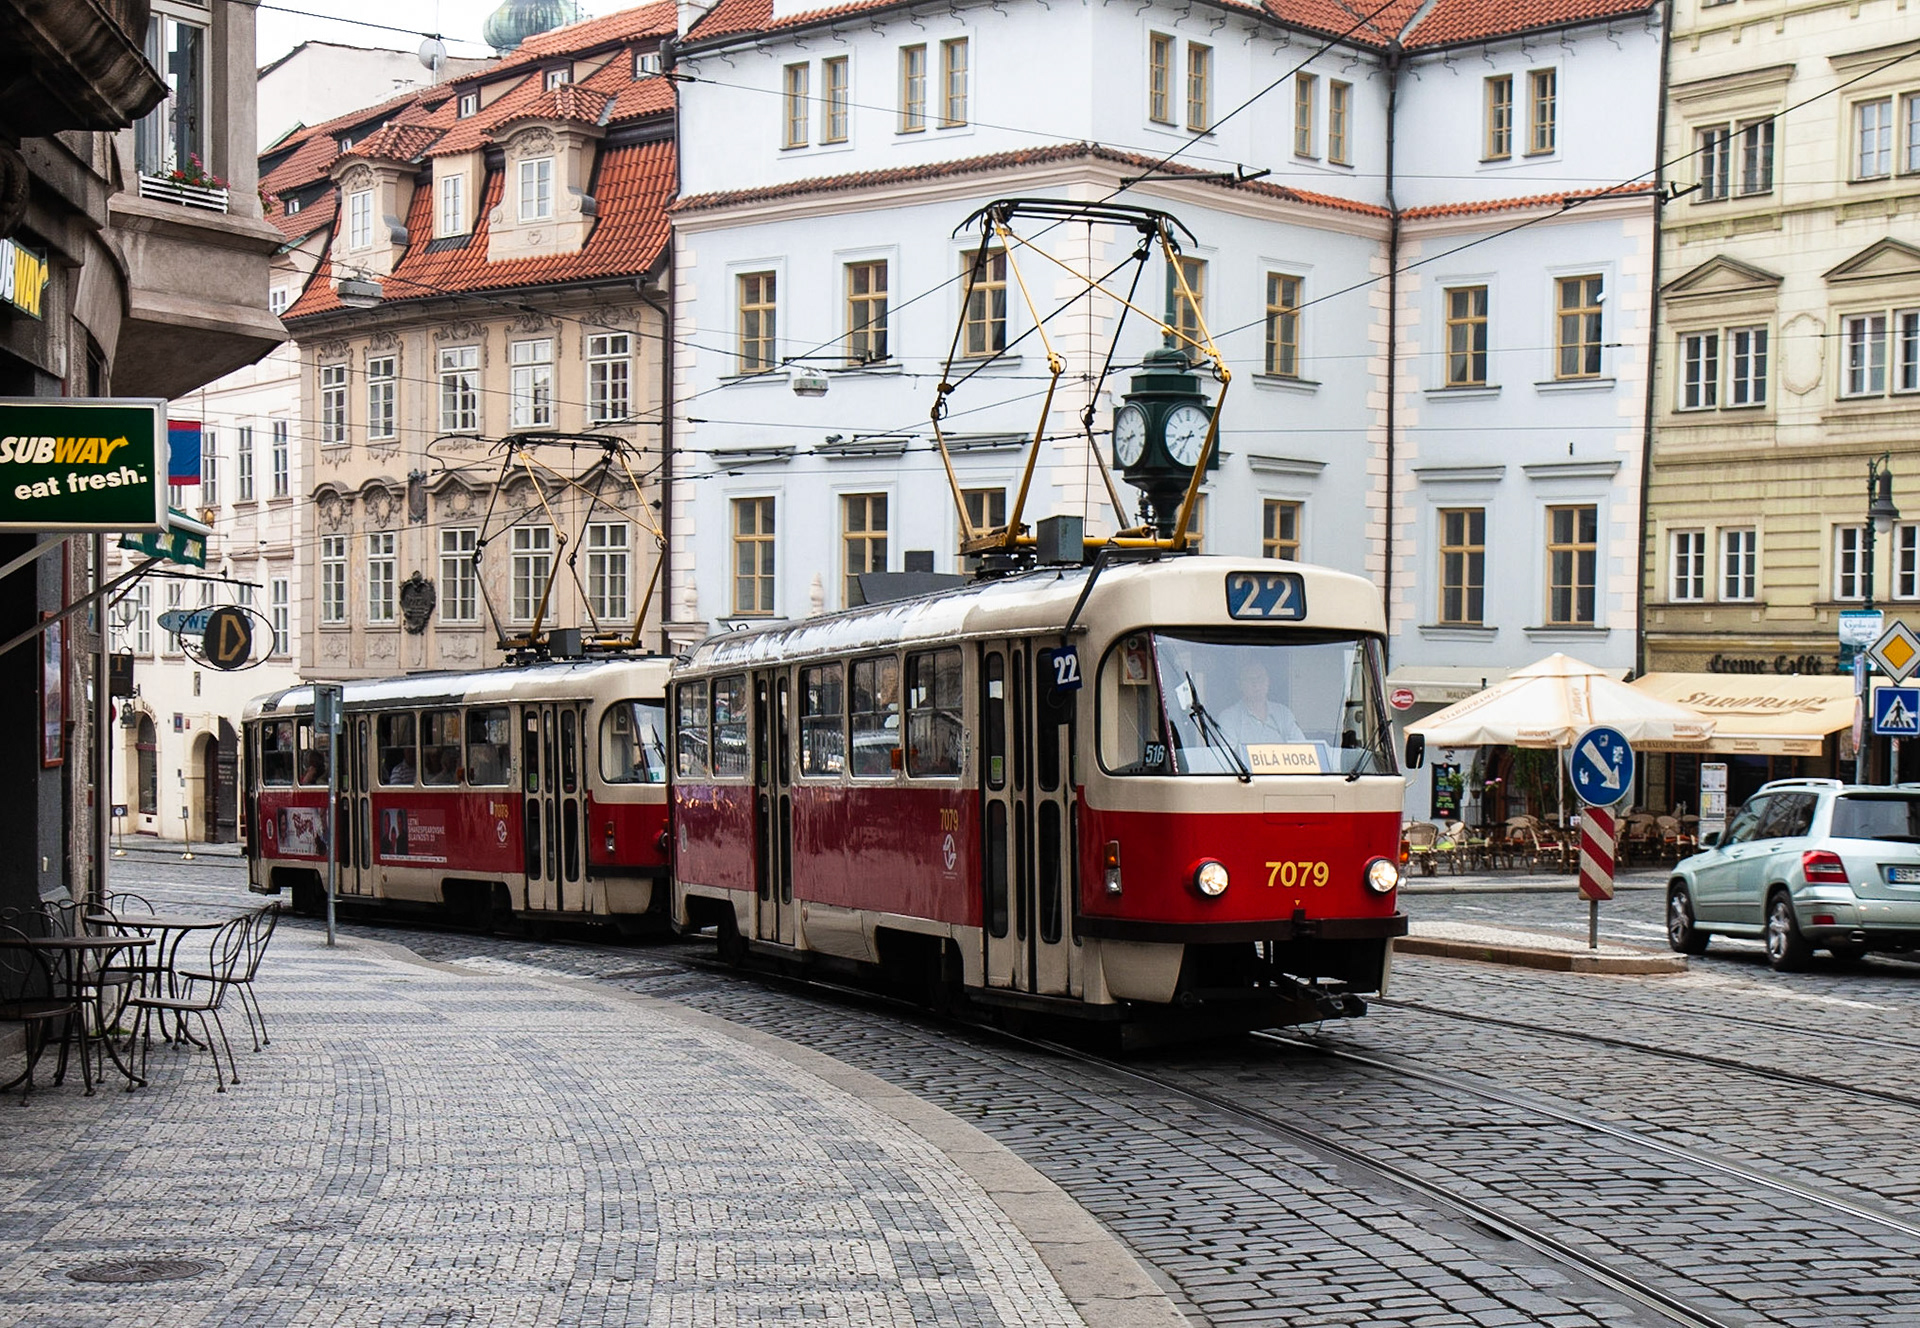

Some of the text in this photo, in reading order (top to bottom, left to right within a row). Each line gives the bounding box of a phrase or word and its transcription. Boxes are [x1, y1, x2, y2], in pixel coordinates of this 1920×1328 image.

[0, 436, 128, 464] SUBWAY
[14, 466, 147, 500] eat fresh.
[1234, 574, 1296, 616] 22
[1053, 653, 1080, 685] 22
[1709, 654, 1766, 675] Creme
[1678, 691, 1831, 709] STAROPRAMEN
[1145, 744, 1165, 763] 516
[1250, 749, 1317, 766] BÍLÁ HORA
[939, 808, 959, 832] 7079
[1265, 861, 1330, 888] 7079
